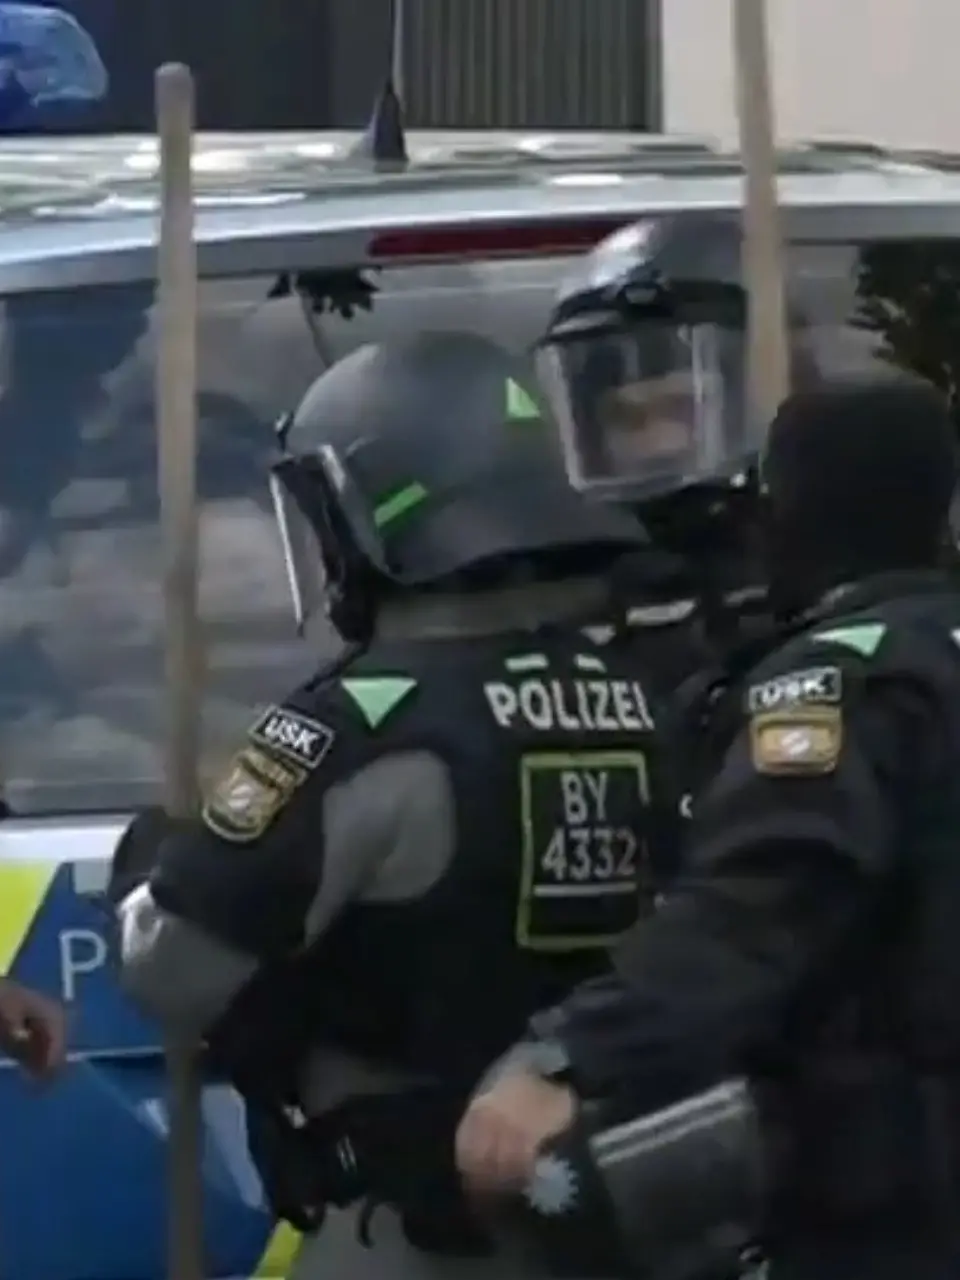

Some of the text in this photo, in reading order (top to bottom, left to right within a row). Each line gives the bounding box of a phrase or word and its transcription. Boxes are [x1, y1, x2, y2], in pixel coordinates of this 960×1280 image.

[483, 677, 656, 732] POLIZEI
[263, 714, 322, 756] USK
[559, 770, 609, 825] BY
[541, 825, 638, 882] 4332
